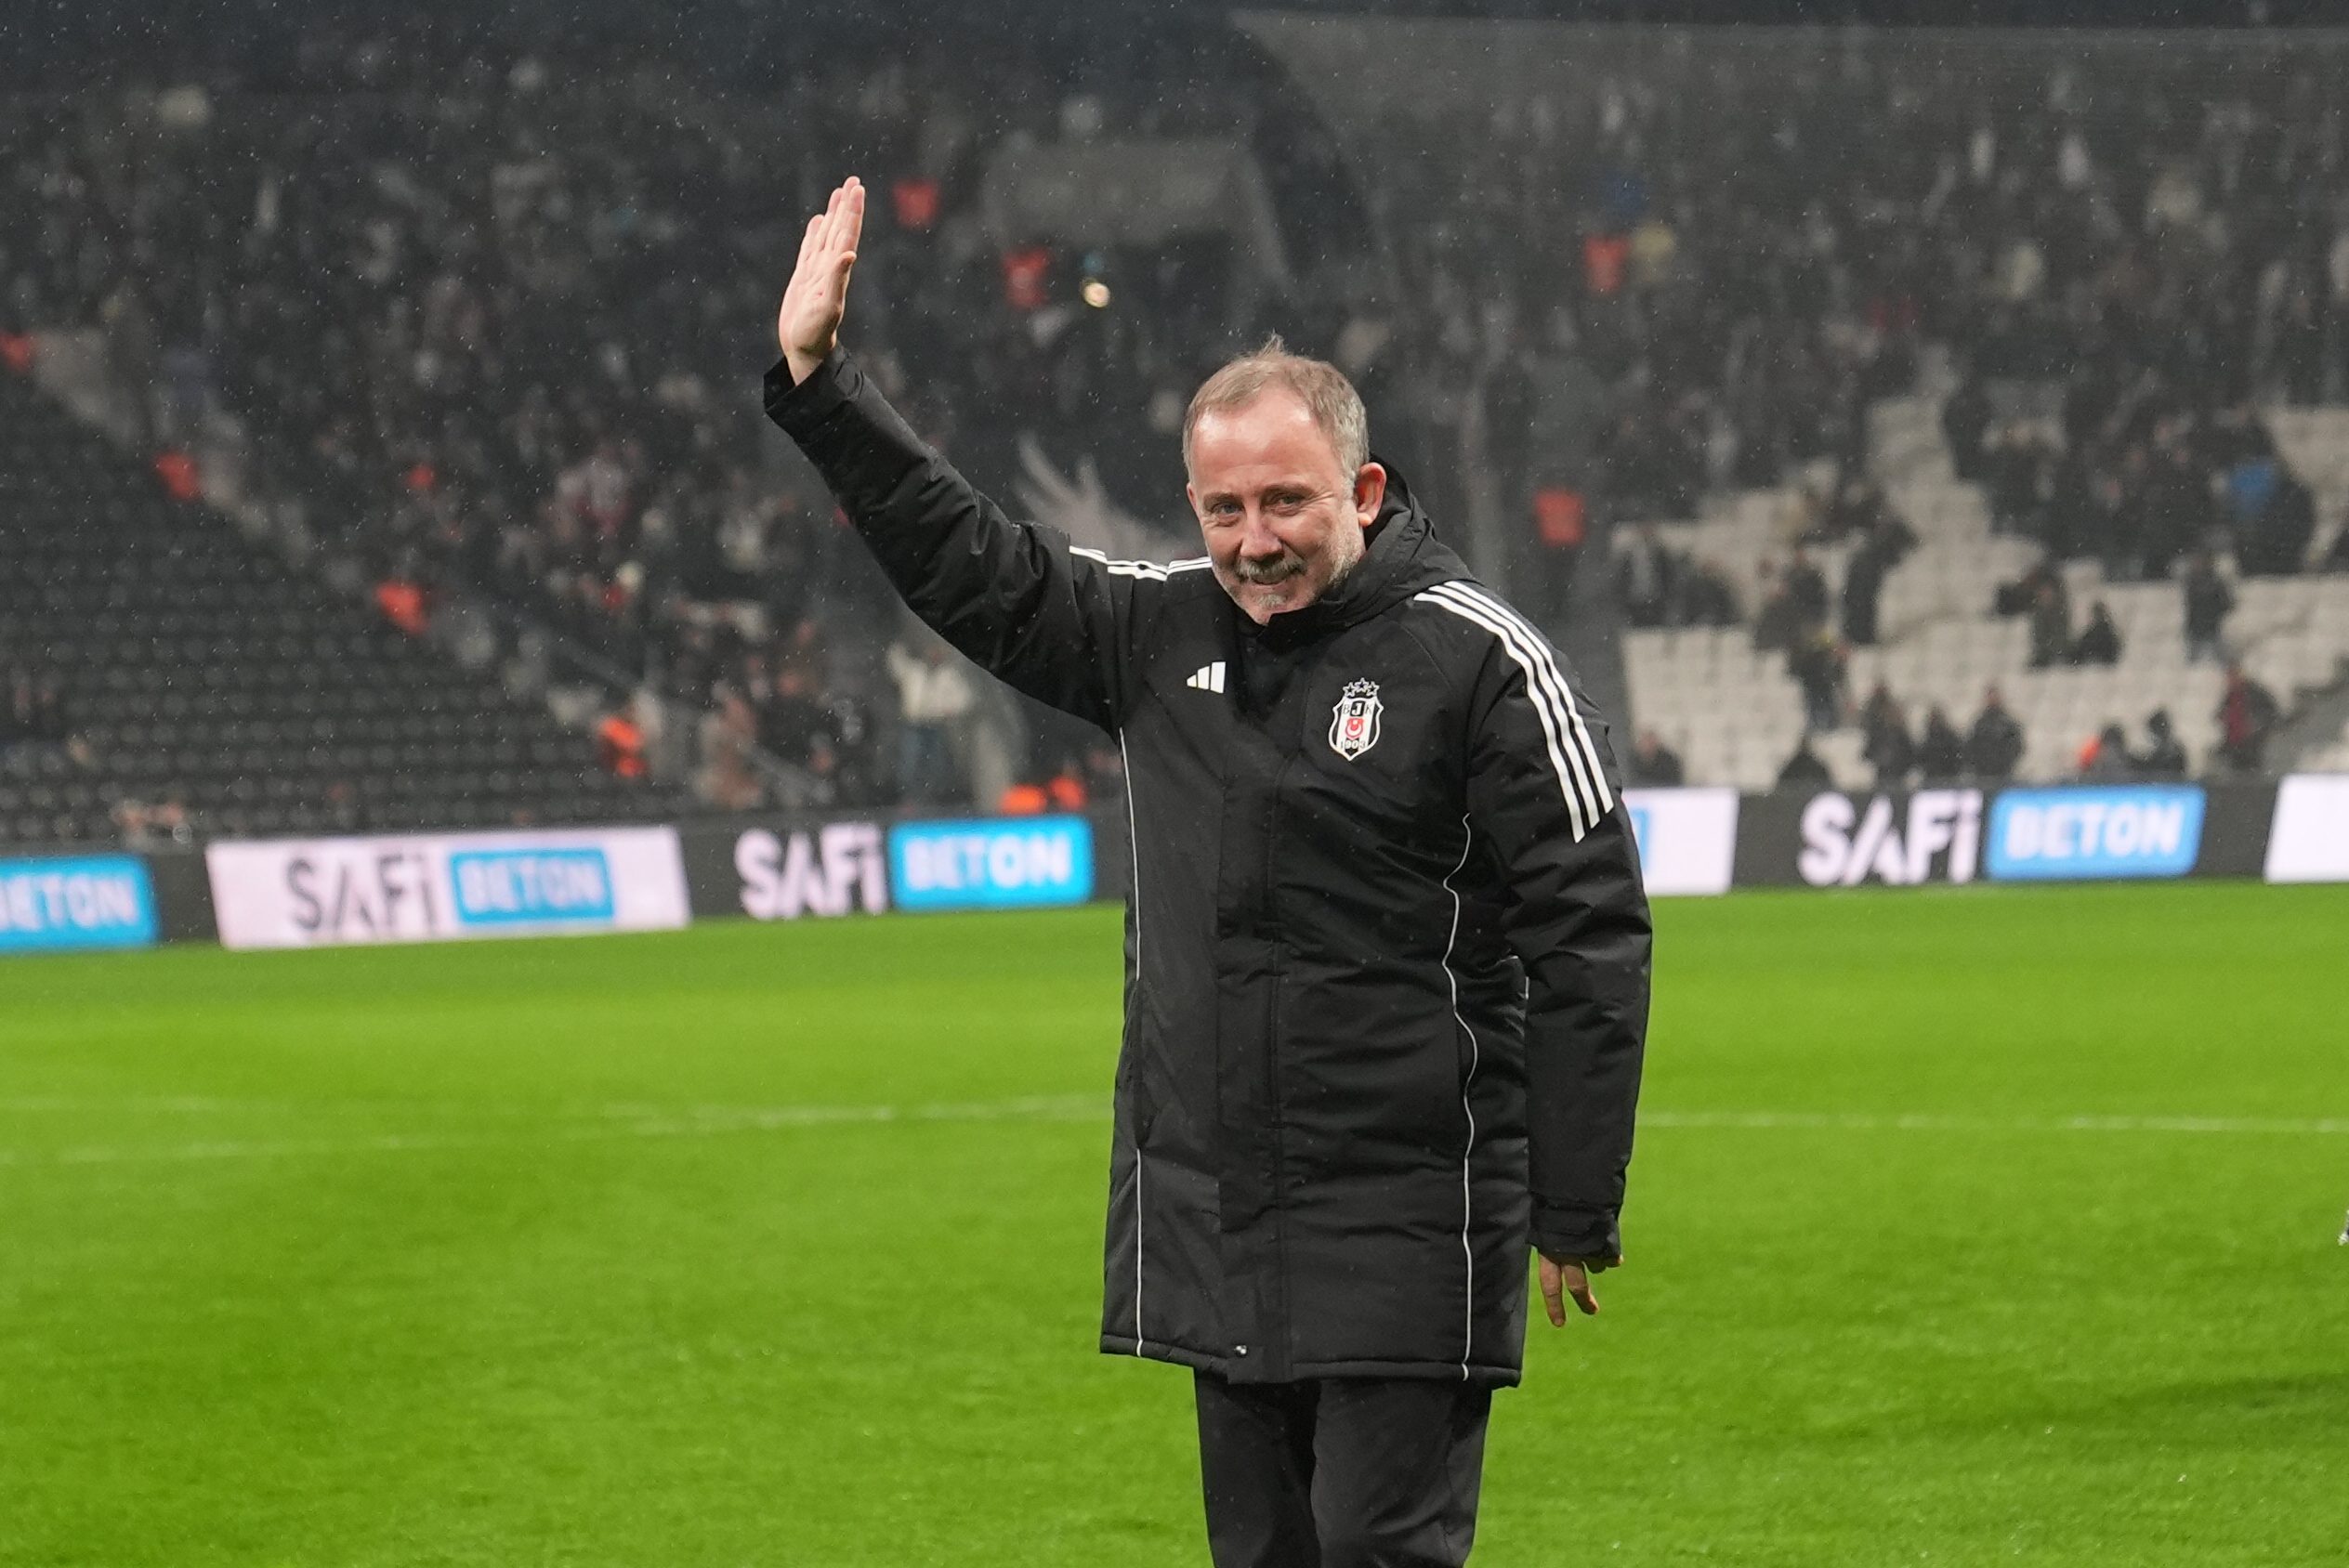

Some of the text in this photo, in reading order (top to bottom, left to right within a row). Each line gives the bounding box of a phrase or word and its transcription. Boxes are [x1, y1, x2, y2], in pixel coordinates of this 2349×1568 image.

[1343, 700, 1372, 716] BJK
[1340, 739, 1366, 750] 1903
[2006, 804, 2184, 858] BETON
[466, 858, 604, 911] BETON
[905, 835, 1070, 890] BETON
